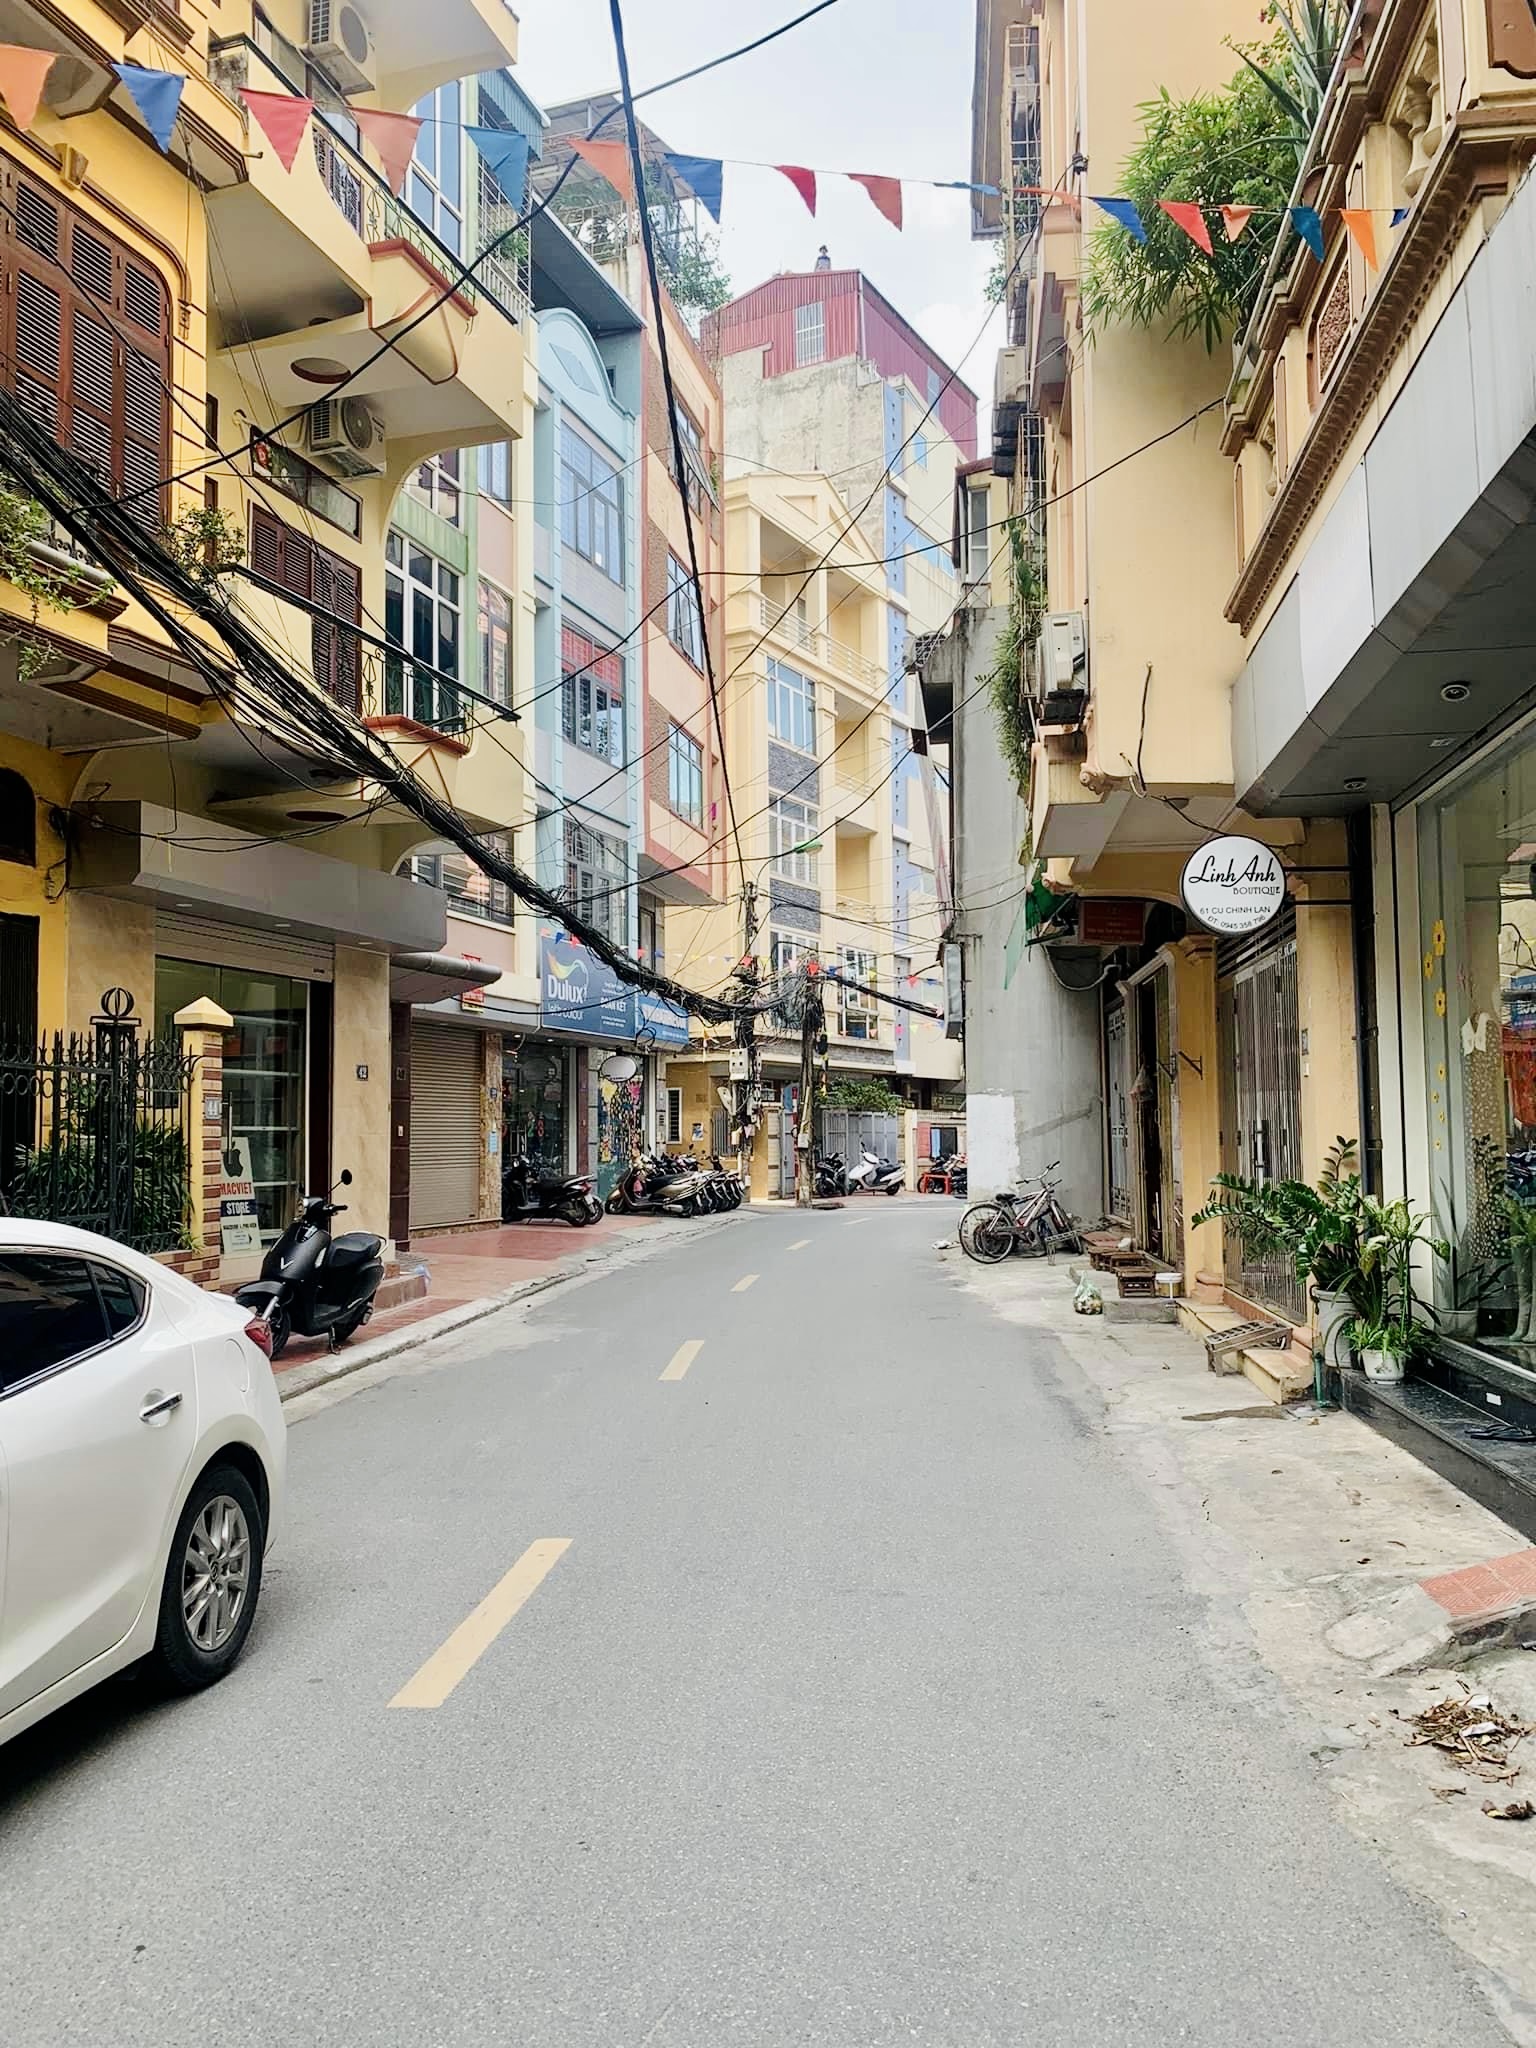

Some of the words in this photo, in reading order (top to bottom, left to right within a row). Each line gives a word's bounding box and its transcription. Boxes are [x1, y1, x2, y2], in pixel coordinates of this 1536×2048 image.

[1188, 855, 1236, 883] Linh
[1221, 854, 1276, 887] Anh
[1232, 886, 1281, 895] BOUTIQUE
[1199, 907, 1209, 915] 61
[1253, 905, 1271, 914] LAN
[547, 974, 583, 1005] Dulux
[220, 1182, 253, 1195] MACVIET
[226, 1202, 251, 1215] STORE
